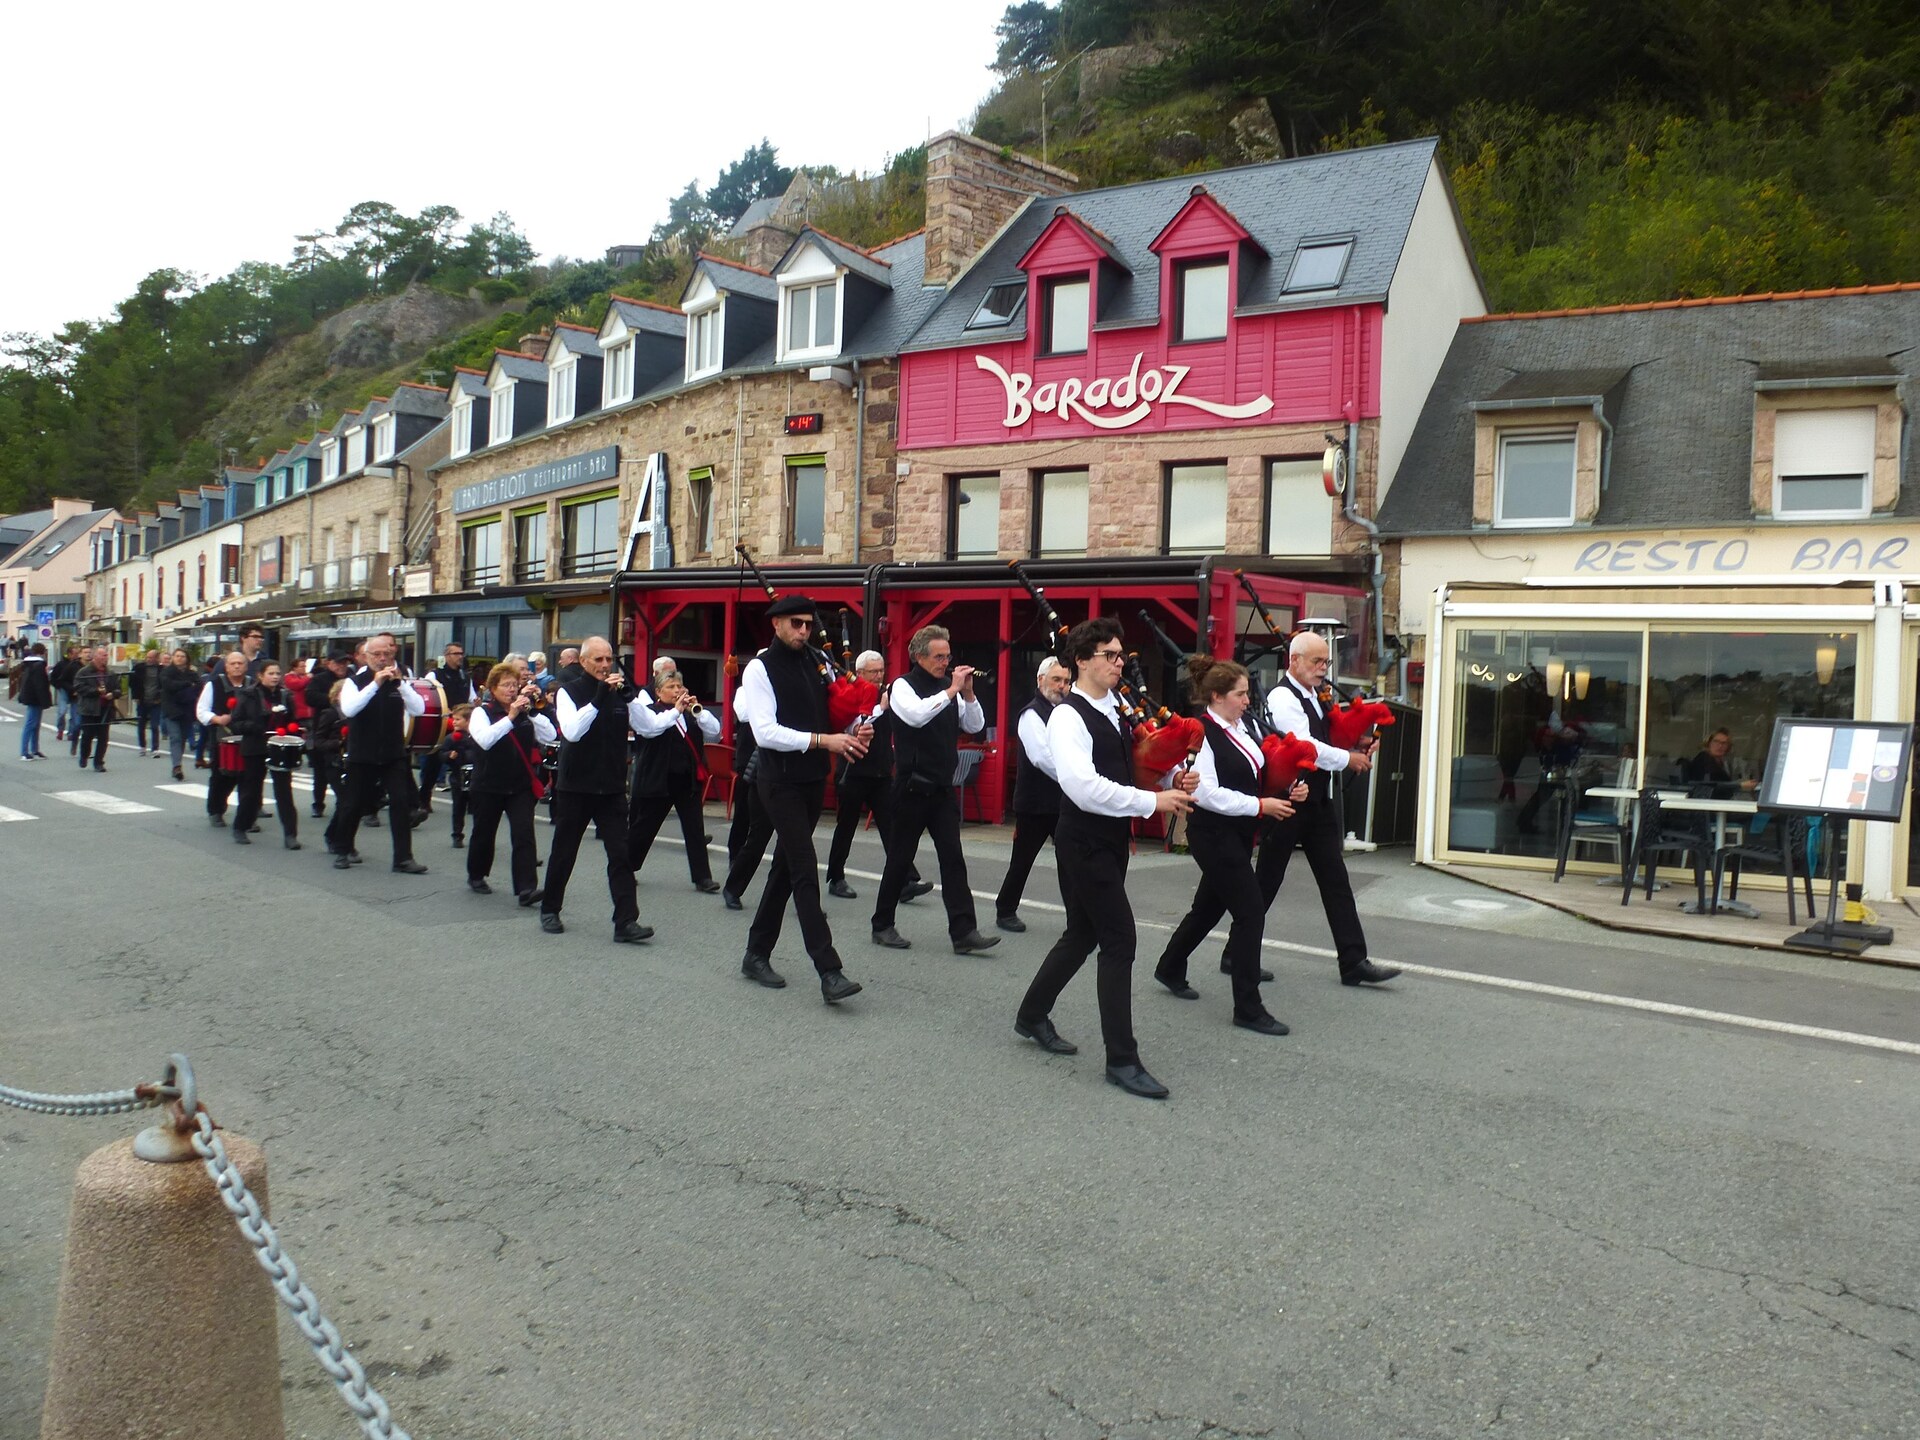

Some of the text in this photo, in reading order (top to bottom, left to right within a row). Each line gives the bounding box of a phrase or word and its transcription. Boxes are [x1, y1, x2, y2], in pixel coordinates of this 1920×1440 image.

[482, 480, 498, 505] DES
[499, 472, 527, 501] FLOTS
[589, 455, 608, 476] BAR
[1574, 536, 1911, 572] RESTO BAR
